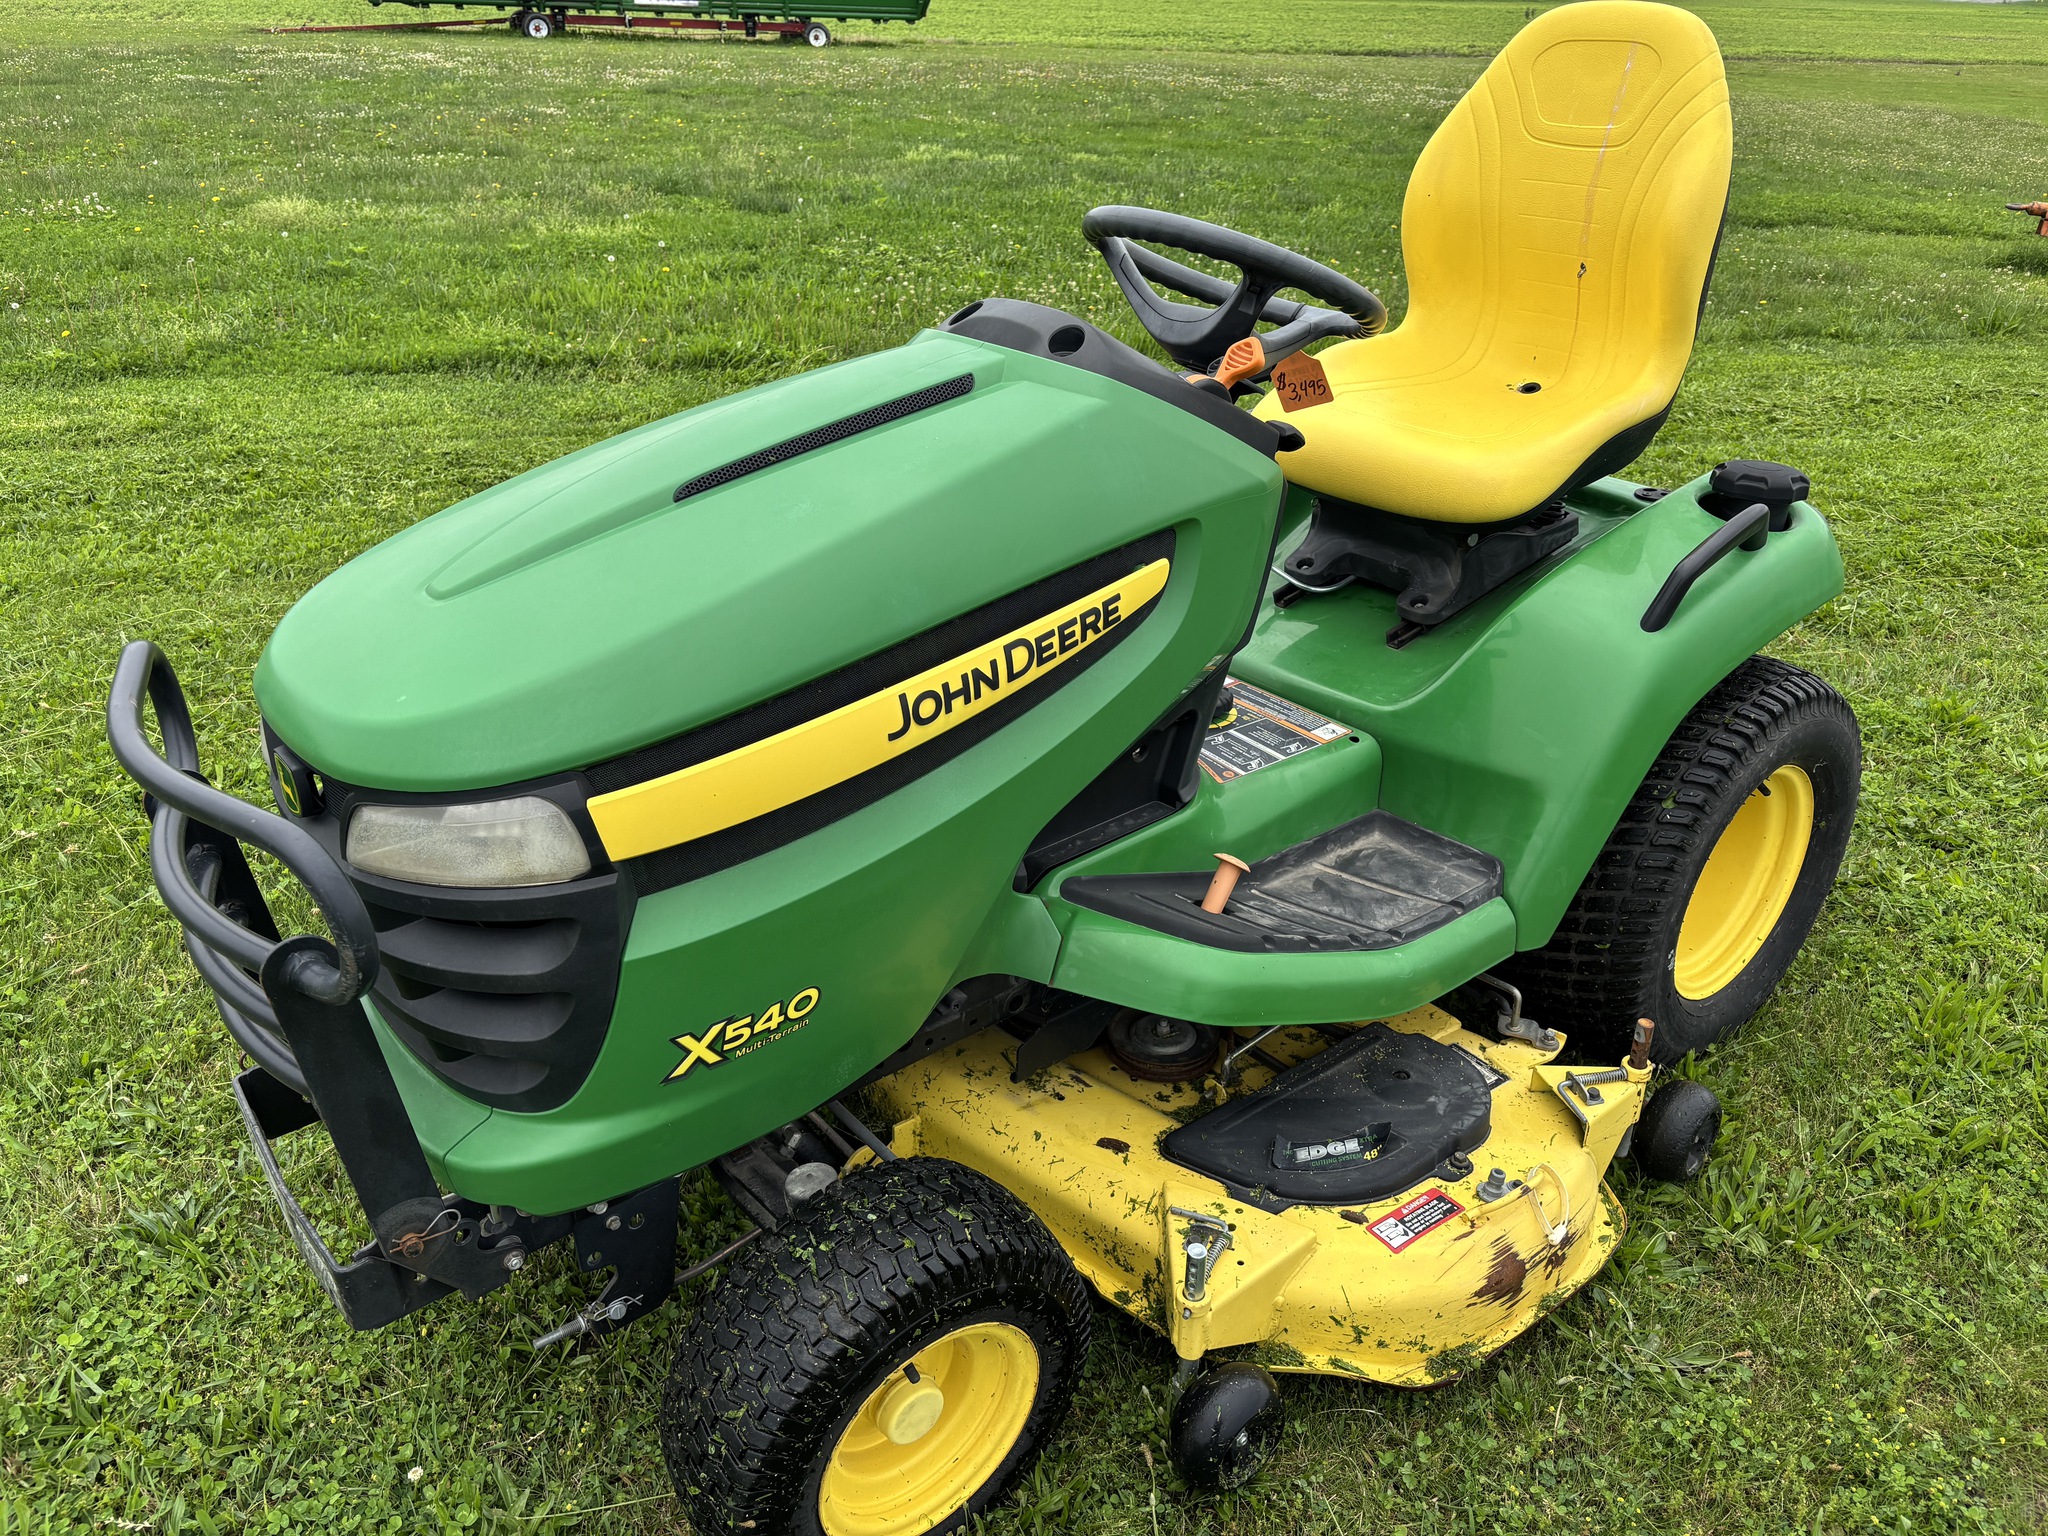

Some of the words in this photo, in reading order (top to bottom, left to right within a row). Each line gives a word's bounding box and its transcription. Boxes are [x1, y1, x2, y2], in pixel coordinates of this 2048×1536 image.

[887, 658, 999, 742] JOHN
[1002, 592, 1122, 683] DEERE
[662, 986, 821, 1083] X540
[735, 1017, 810, 1059] Multi-Terrain
[1294, 1138, 1361, 1163] EDGE
[1405, 1194, 1430, 1211] DANGER
